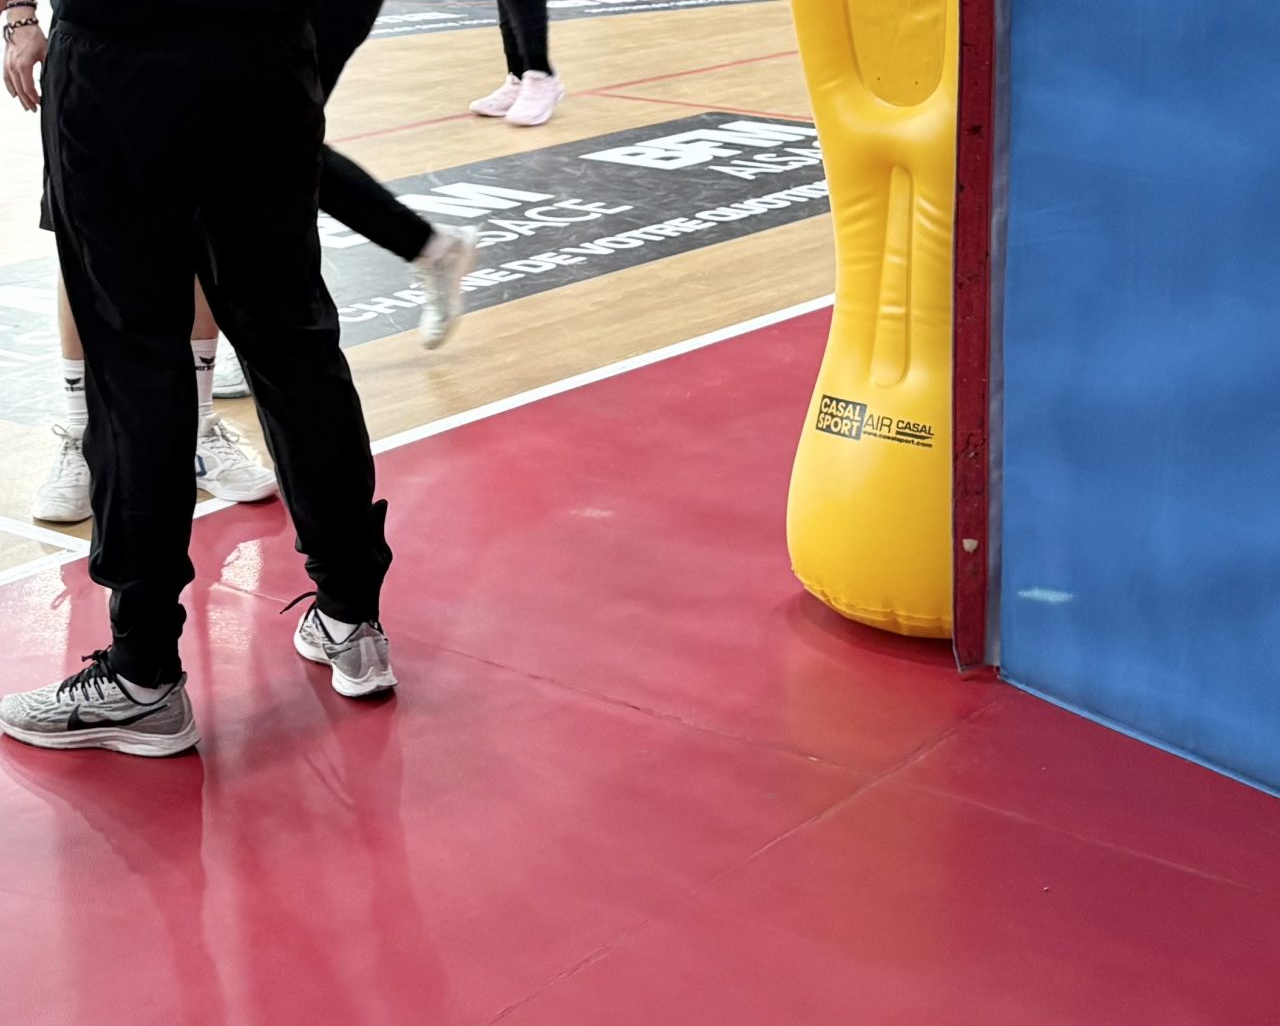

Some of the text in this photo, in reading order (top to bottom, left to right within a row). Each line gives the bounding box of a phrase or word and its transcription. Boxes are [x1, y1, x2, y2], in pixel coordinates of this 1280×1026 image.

[578, 120, 817, 171] BFM
[707, 140, 823, 180] ALSA
[337, 267, 526, 323] CHANE
[500, 251, 588, 274] DE
[558, 216, 718, 255] VOTRE
[817, 412, 935, 437] SPORT AIR CASAL
[821, 397, 863, 421] CASAL
